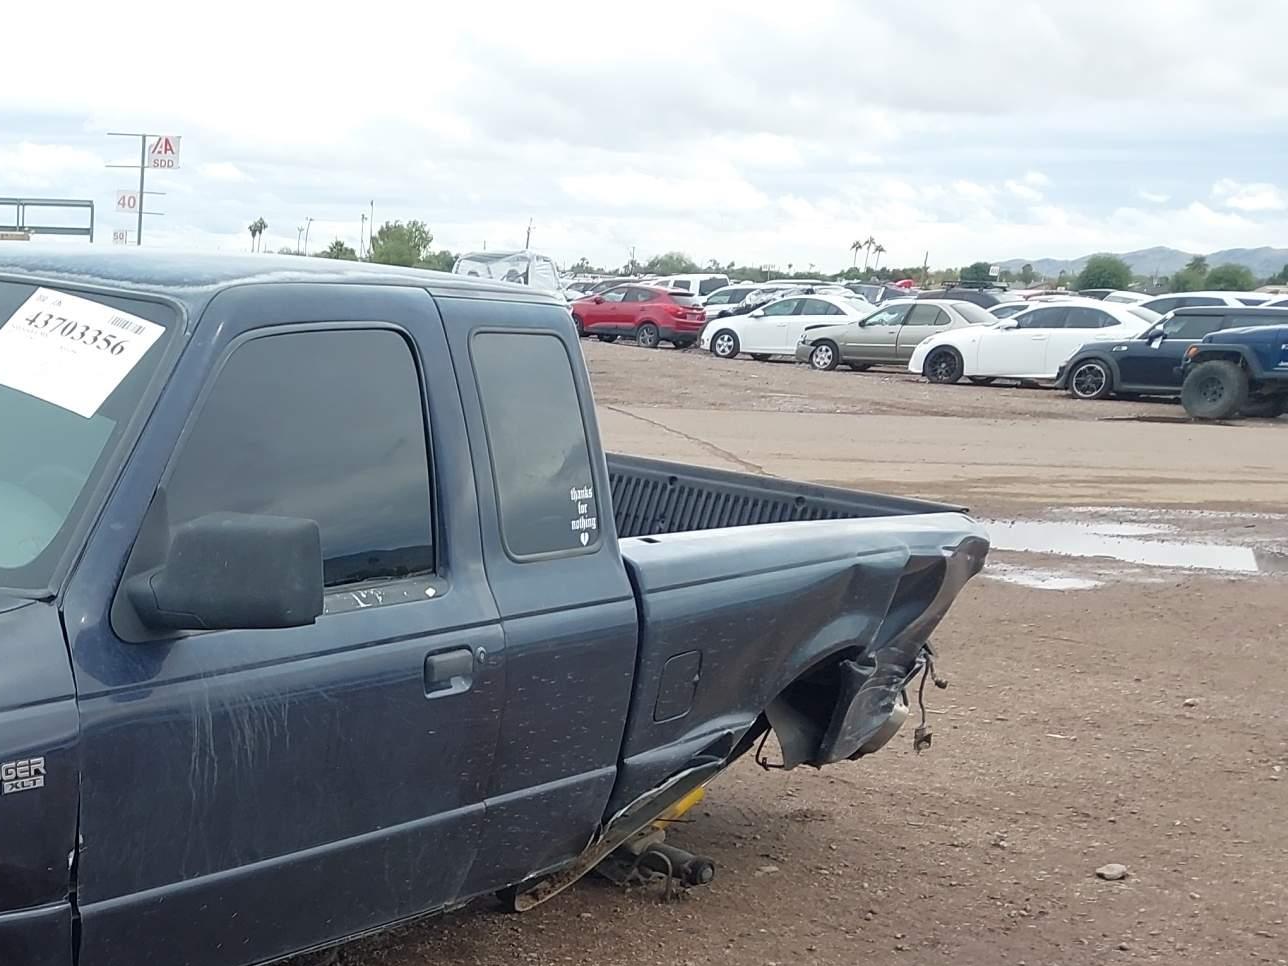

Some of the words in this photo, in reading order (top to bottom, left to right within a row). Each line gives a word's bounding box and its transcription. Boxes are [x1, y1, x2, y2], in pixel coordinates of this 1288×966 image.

[117, 195, 136, 208] 40
[25, 311, 130, 356] 43703356
[570, 486, 593, 502] thanks
[577, 501, 588, 514] for
[571, 515, 596, 531] nothing
[6, 777, 41, 792] XLT
